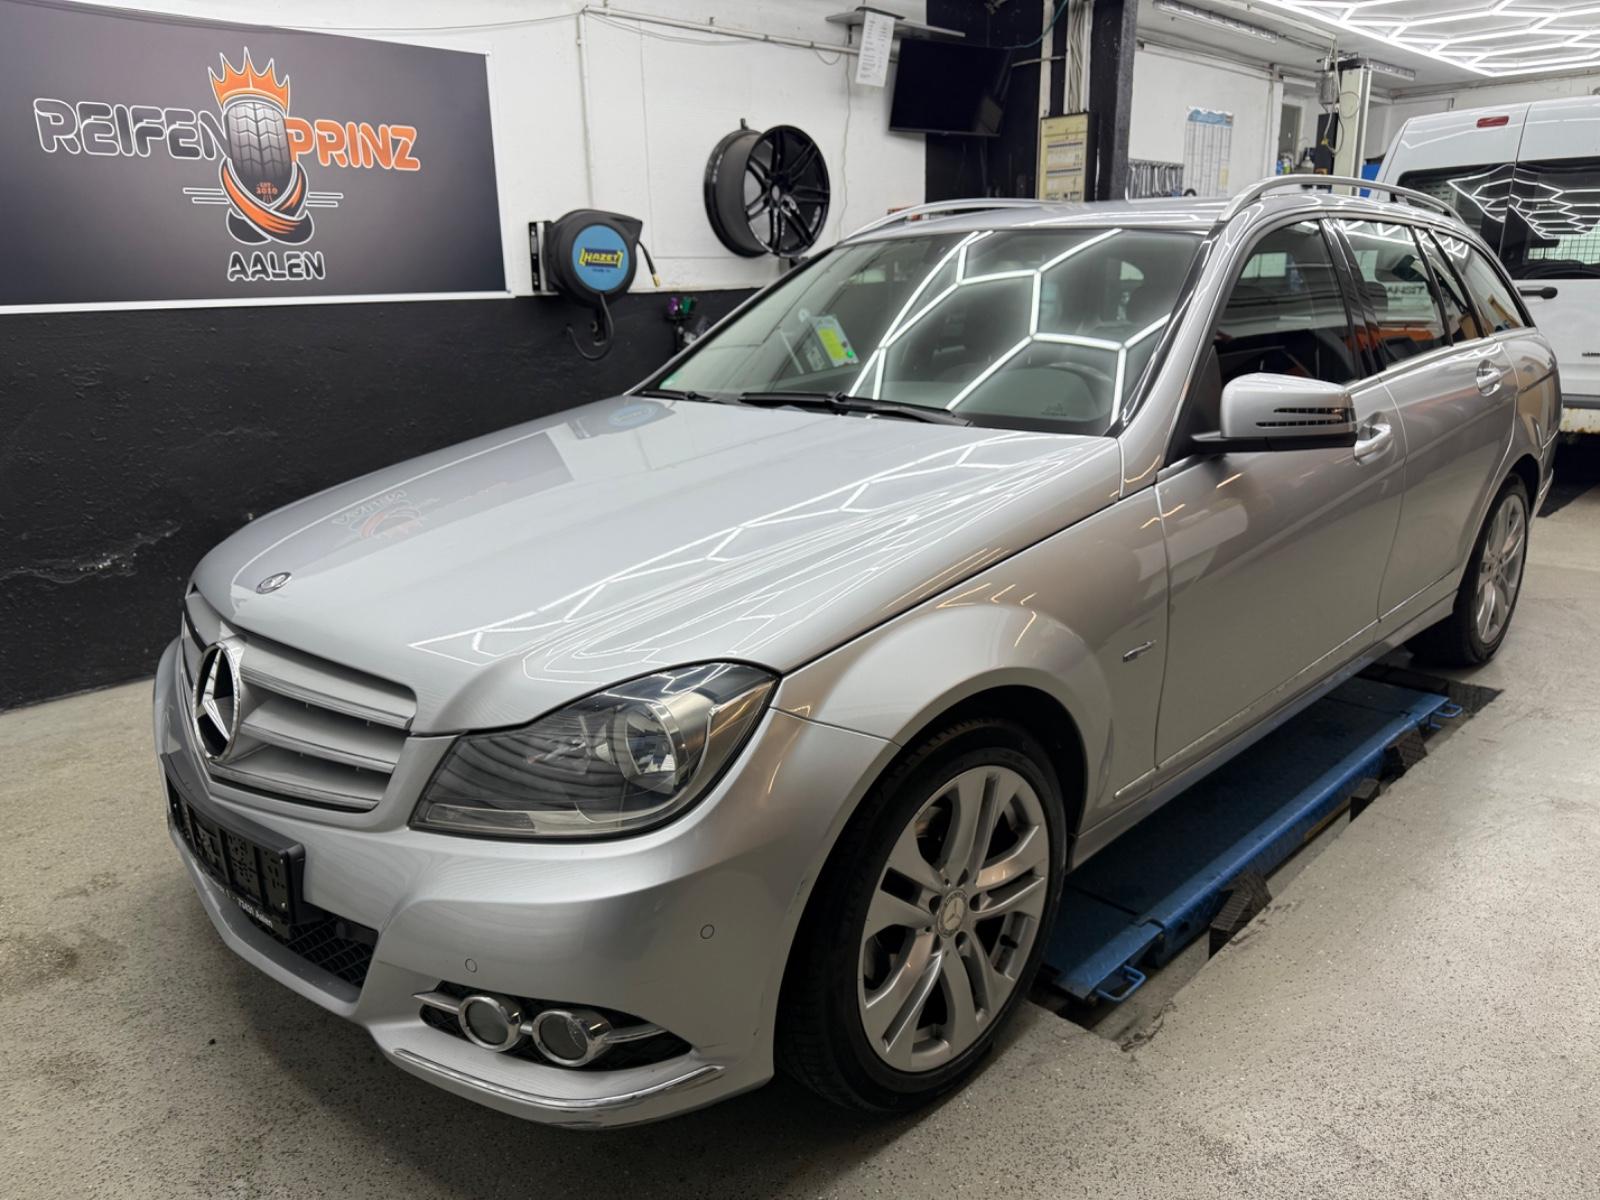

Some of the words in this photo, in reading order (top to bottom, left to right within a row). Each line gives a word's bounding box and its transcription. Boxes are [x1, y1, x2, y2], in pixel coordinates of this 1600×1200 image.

[33, 98, 229, 160] REIFEN
[284, 117, 421, 171] PRINZ
[226, 251, 325, 281] AALEN
[582, 250, 620, 264] HAZET
